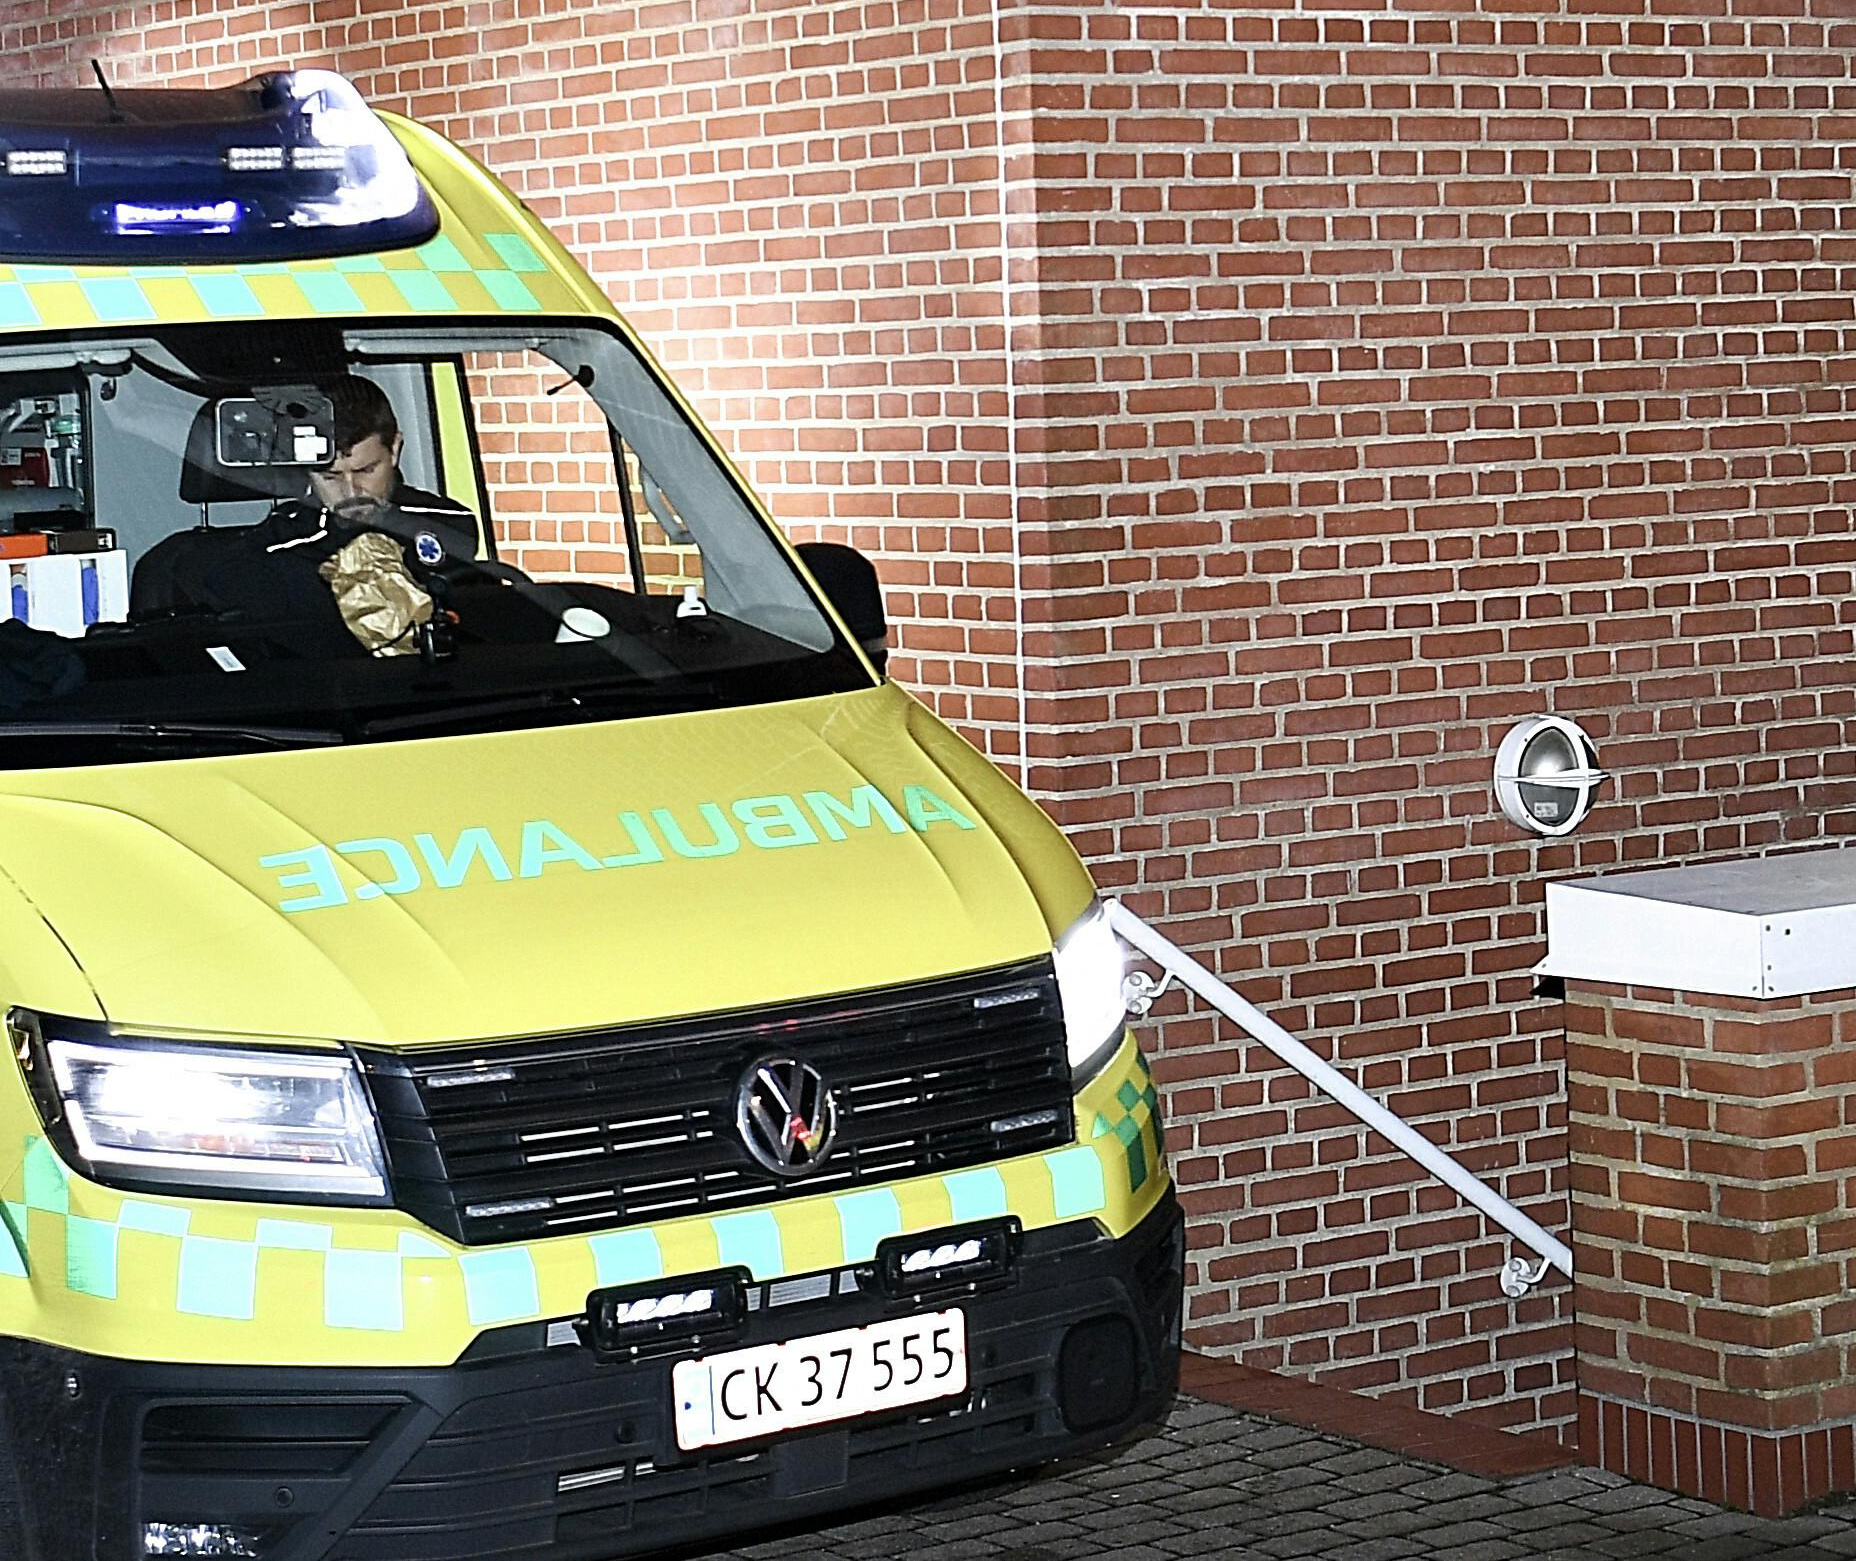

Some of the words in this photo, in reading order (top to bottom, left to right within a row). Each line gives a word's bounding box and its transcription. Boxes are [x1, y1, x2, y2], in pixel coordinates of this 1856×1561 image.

[720, 1362, 783, 1421] CK
[799, 1347, 853, 1407] 37
[873, 1327, 954, 1391] 555
